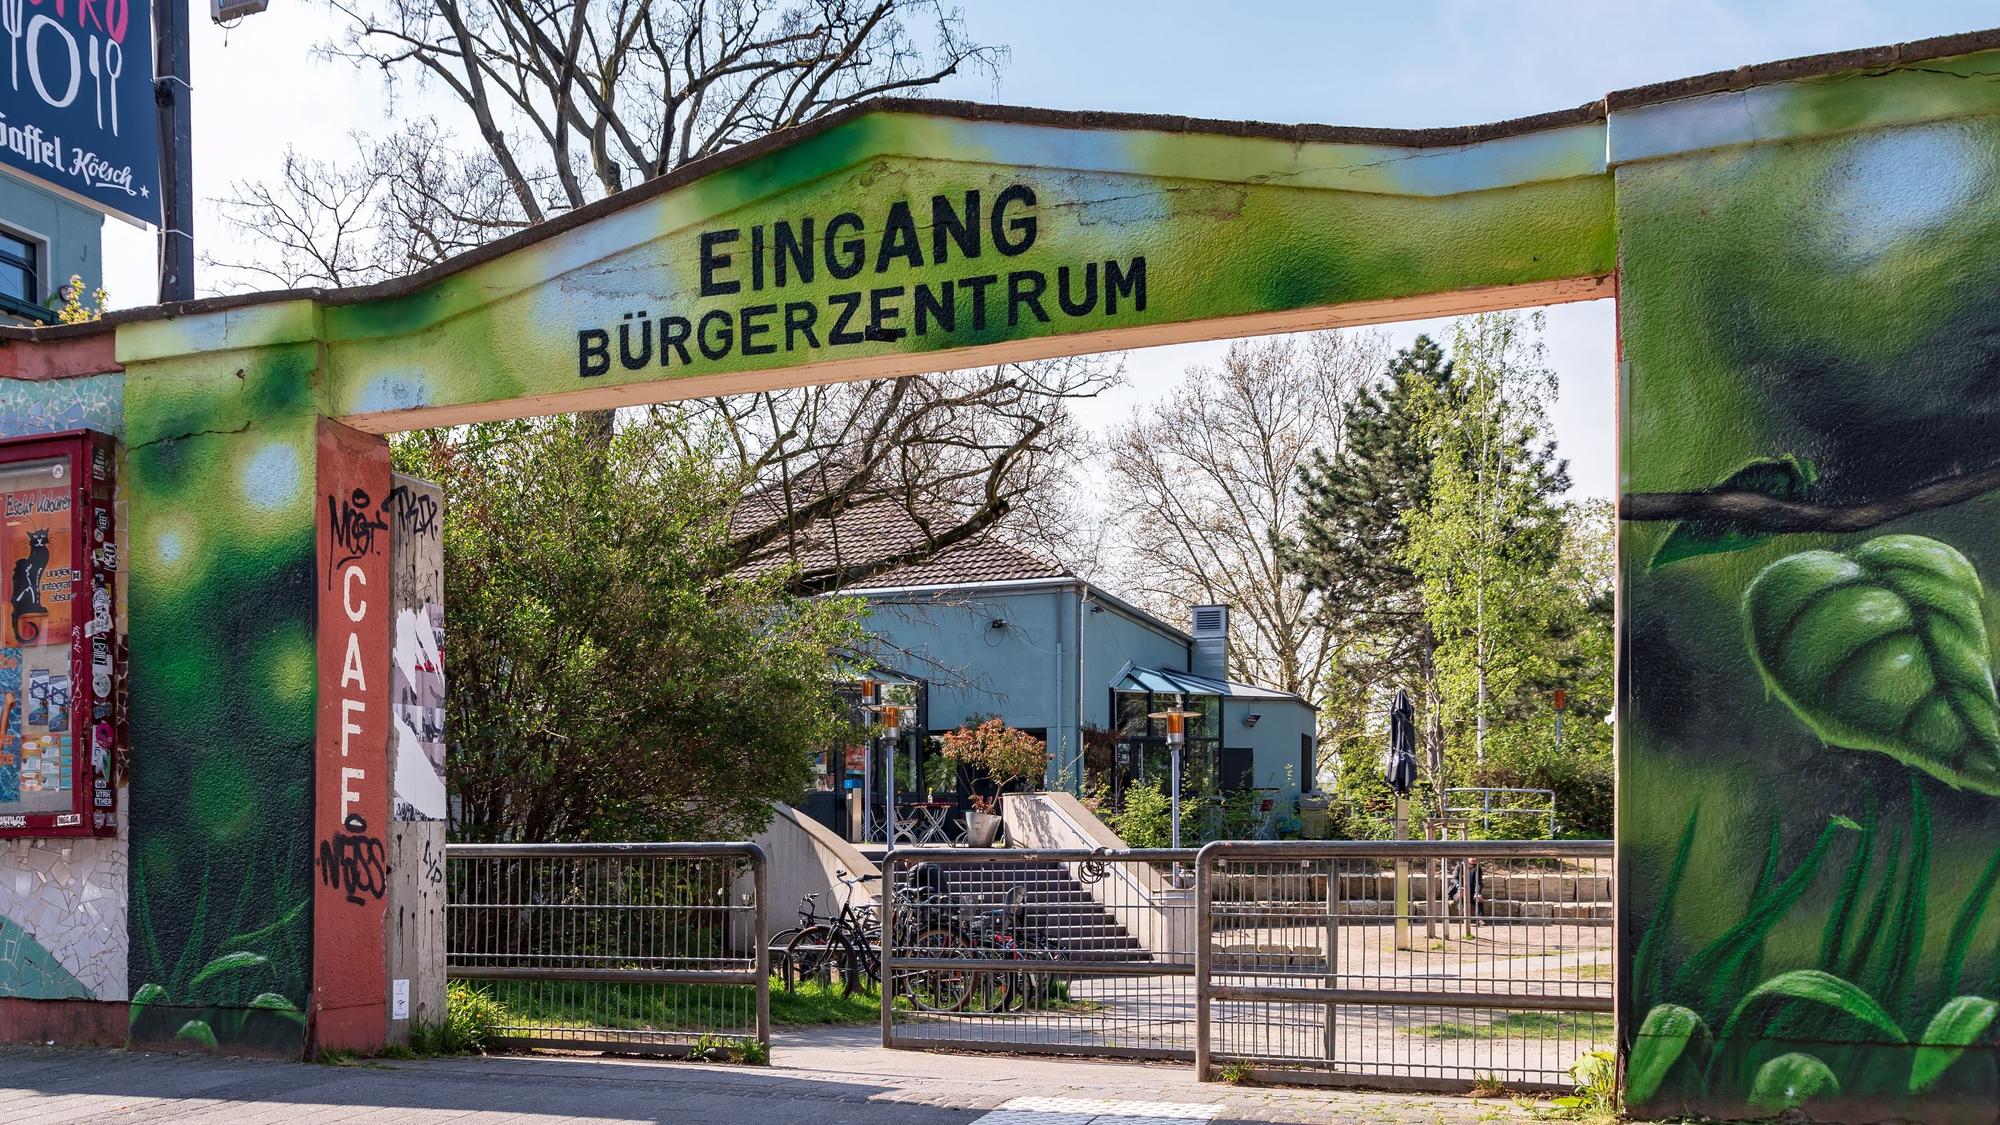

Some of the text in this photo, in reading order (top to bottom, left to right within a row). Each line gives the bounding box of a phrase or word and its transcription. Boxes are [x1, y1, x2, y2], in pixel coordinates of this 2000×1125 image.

[68, 147, 137, 197] Kölsch
[699, 184, 1038, 298] EINGANG
[578, 256, 1147, 378] BÜRGERZENTRUM
[340, 565, 368, 827] CAFFE
